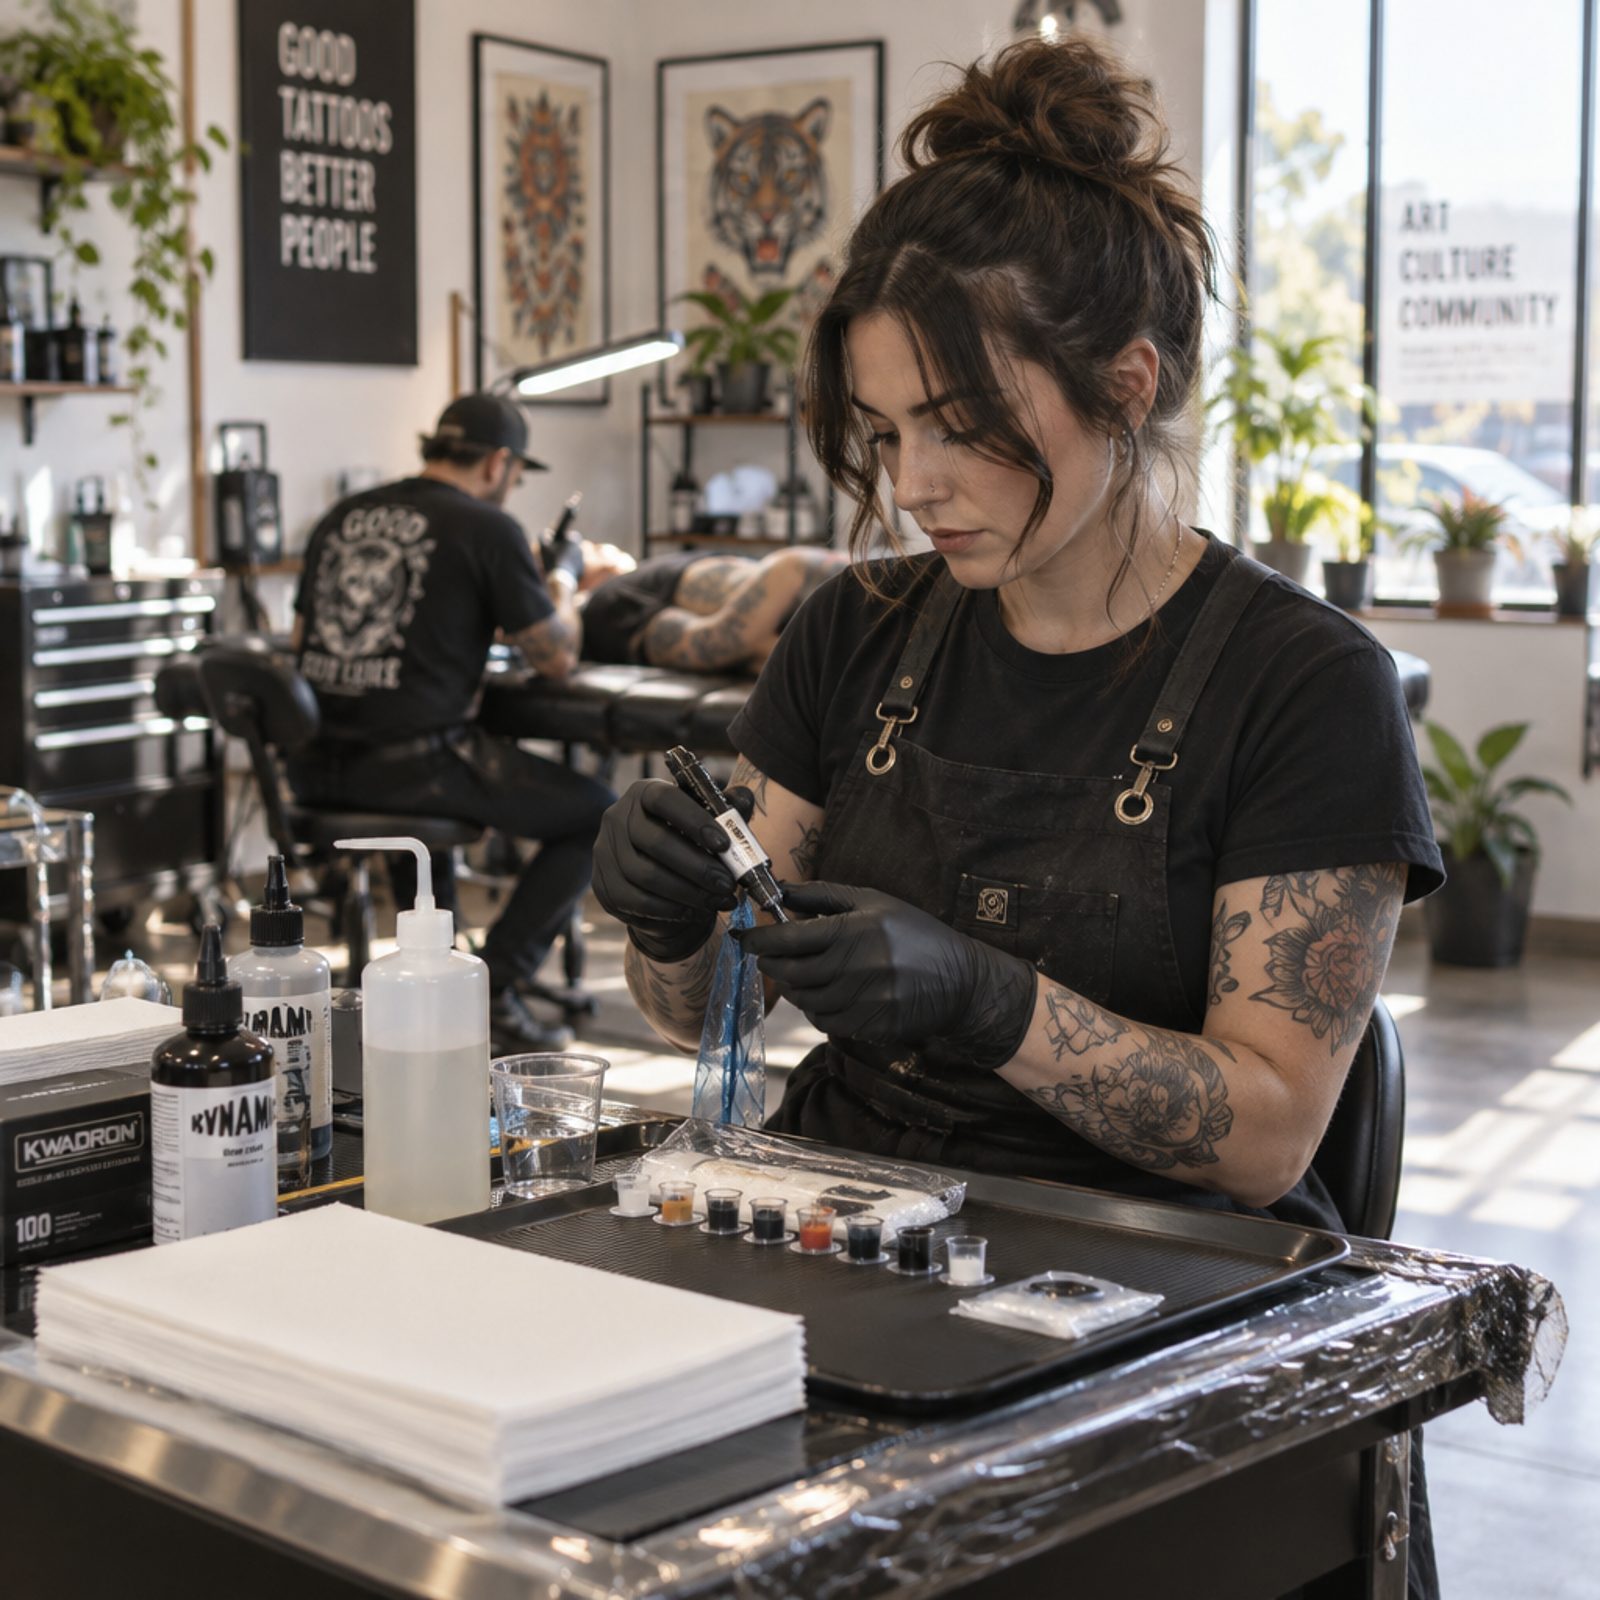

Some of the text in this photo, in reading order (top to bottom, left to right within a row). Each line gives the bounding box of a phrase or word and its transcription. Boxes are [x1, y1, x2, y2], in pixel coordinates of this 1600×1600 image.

[278, 21, 357, 87] GOOD
[278, 84, 393, 155] TATTOOS
[280, 149, 376, 214] BETTER
[1402, 201, 1449, 232] ART
[281, 212, 378, 274] PEOPLE
[1401, 245, 1514, 282] CULTURE
[1401, 293, 1559, 329] COMMUNITY
[23, 1123, 136, 1163] KWADRON
[16, 1212, 52, 1244] 100
